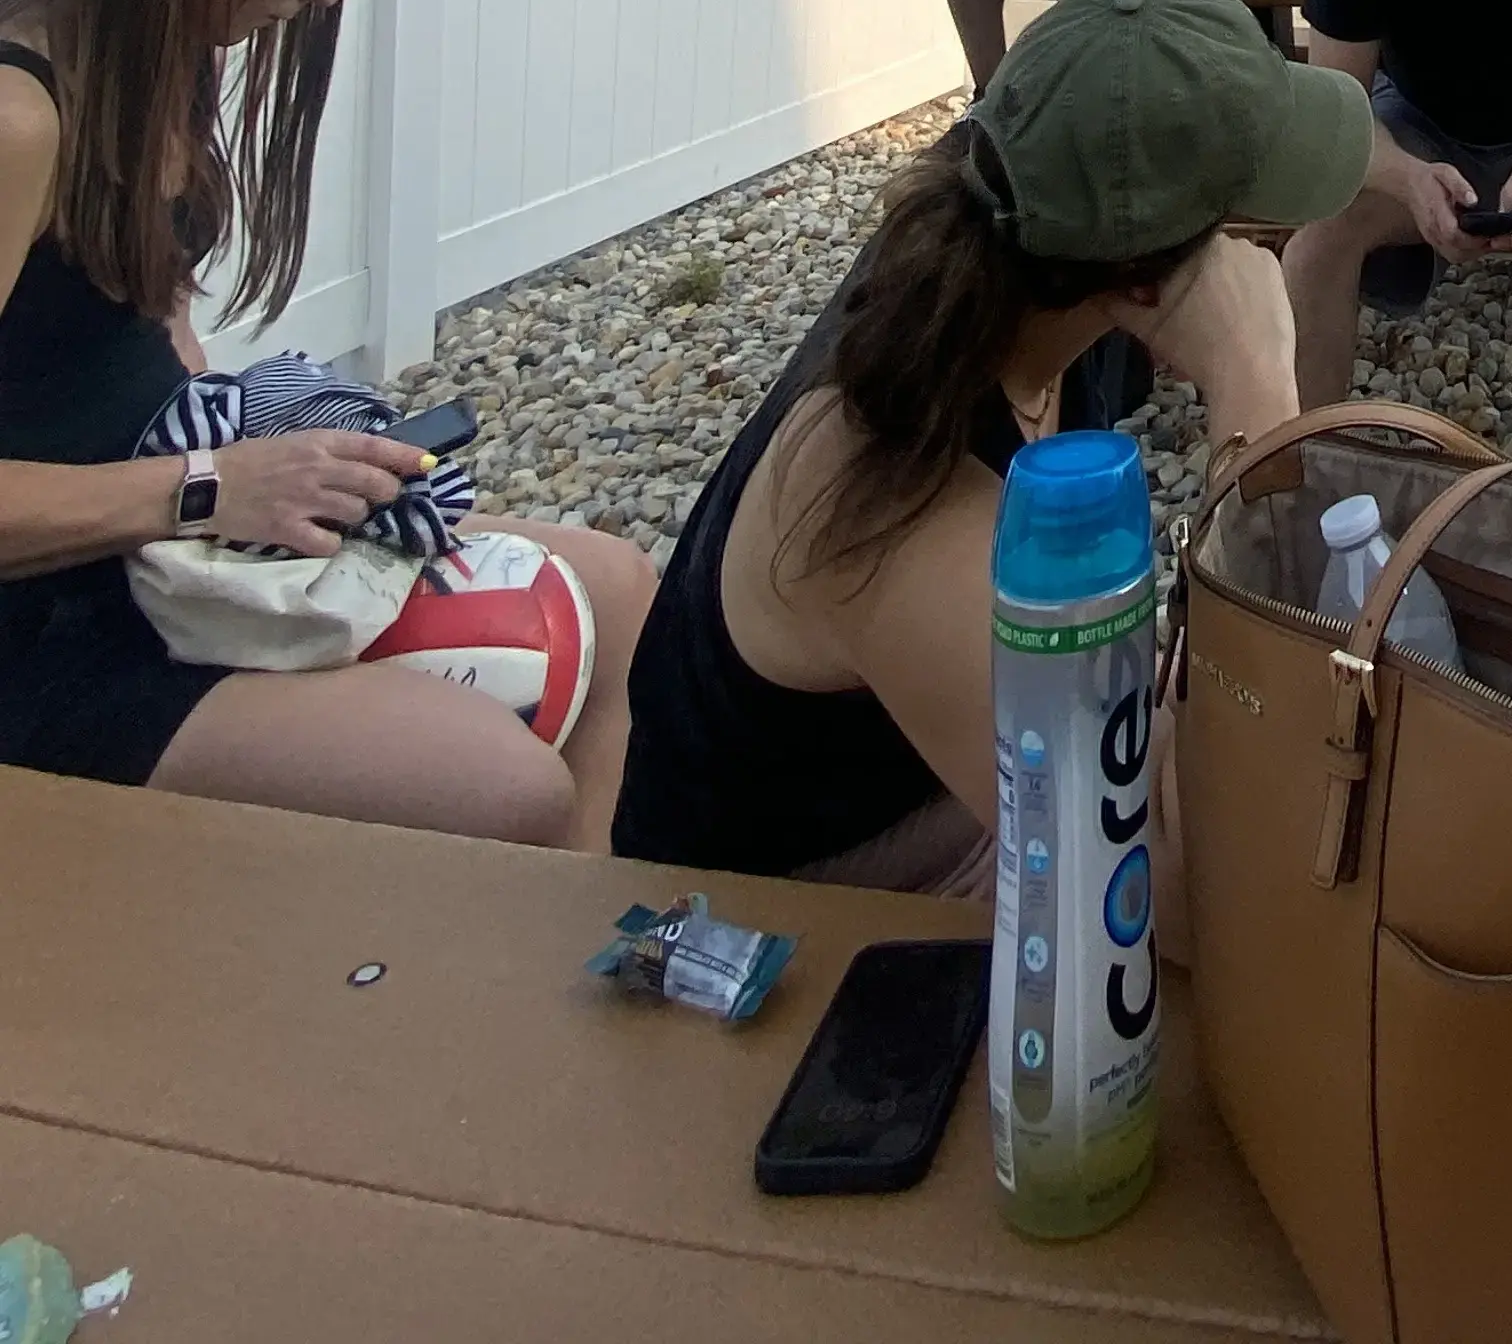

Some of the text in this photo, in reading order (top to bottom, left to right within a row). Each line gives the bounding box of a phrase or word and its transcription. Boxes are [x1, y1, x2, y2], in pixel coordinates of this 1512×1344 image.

[1014, 631, 1044, 649] PLASTIC
[1077, 623, 1112, 645] BOTTLE
[1101, 685, 1157, 1040] core
